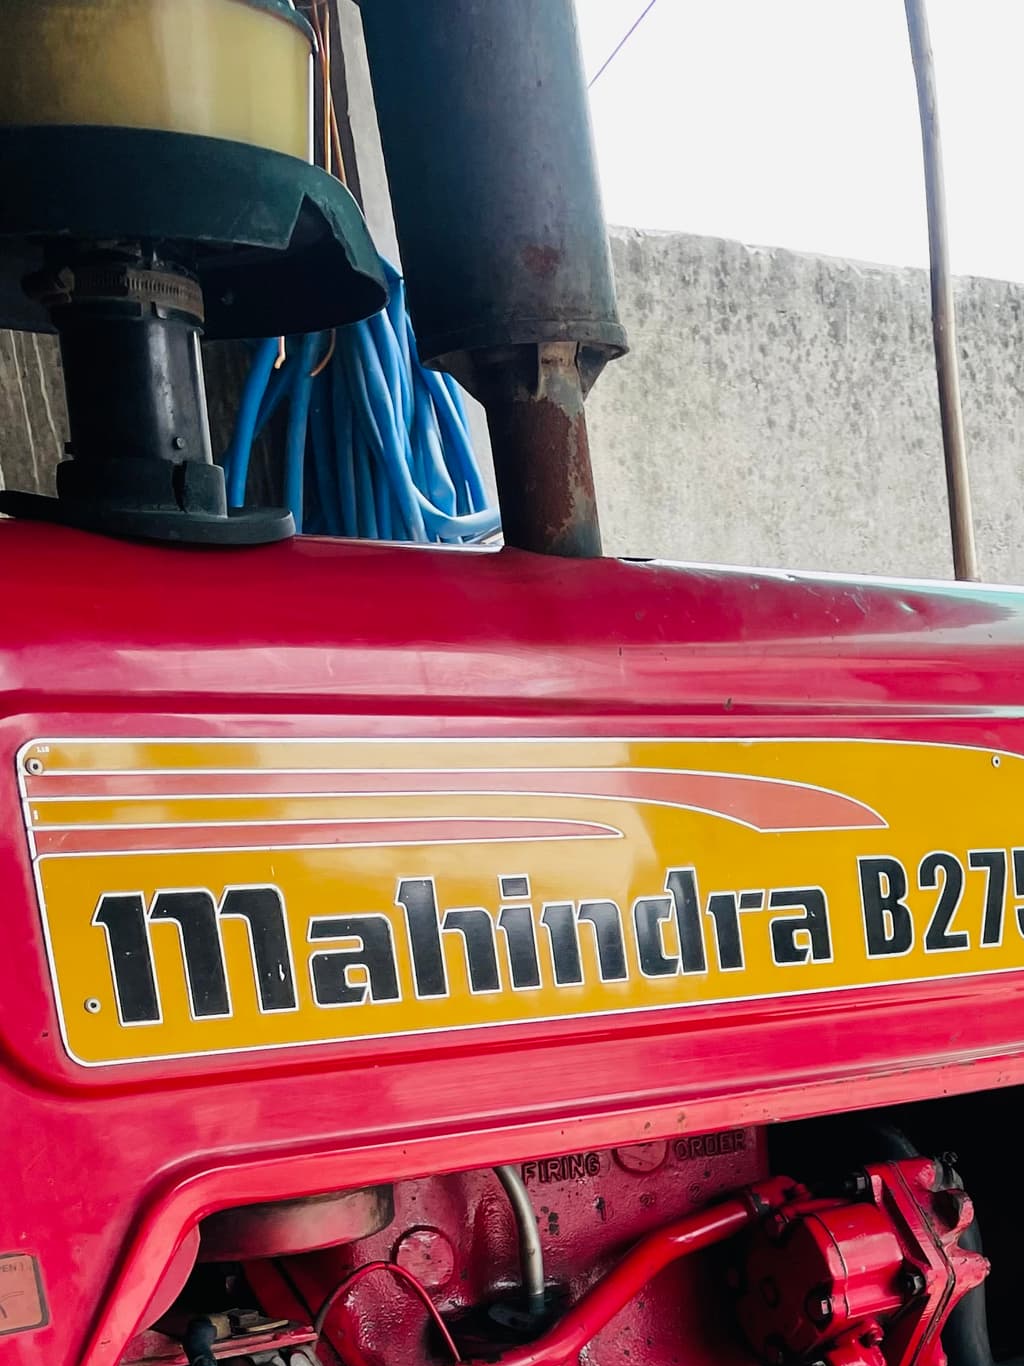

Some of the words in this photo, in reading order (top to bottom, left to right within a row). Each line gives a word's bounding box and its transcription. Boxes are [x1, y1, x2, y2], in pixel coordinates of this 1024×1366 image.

[91, 866, 834, 1027] Mahindra
[521, 1152, 600, 1185] FIRING
[673, 1130, 745, 1161] ORDER
